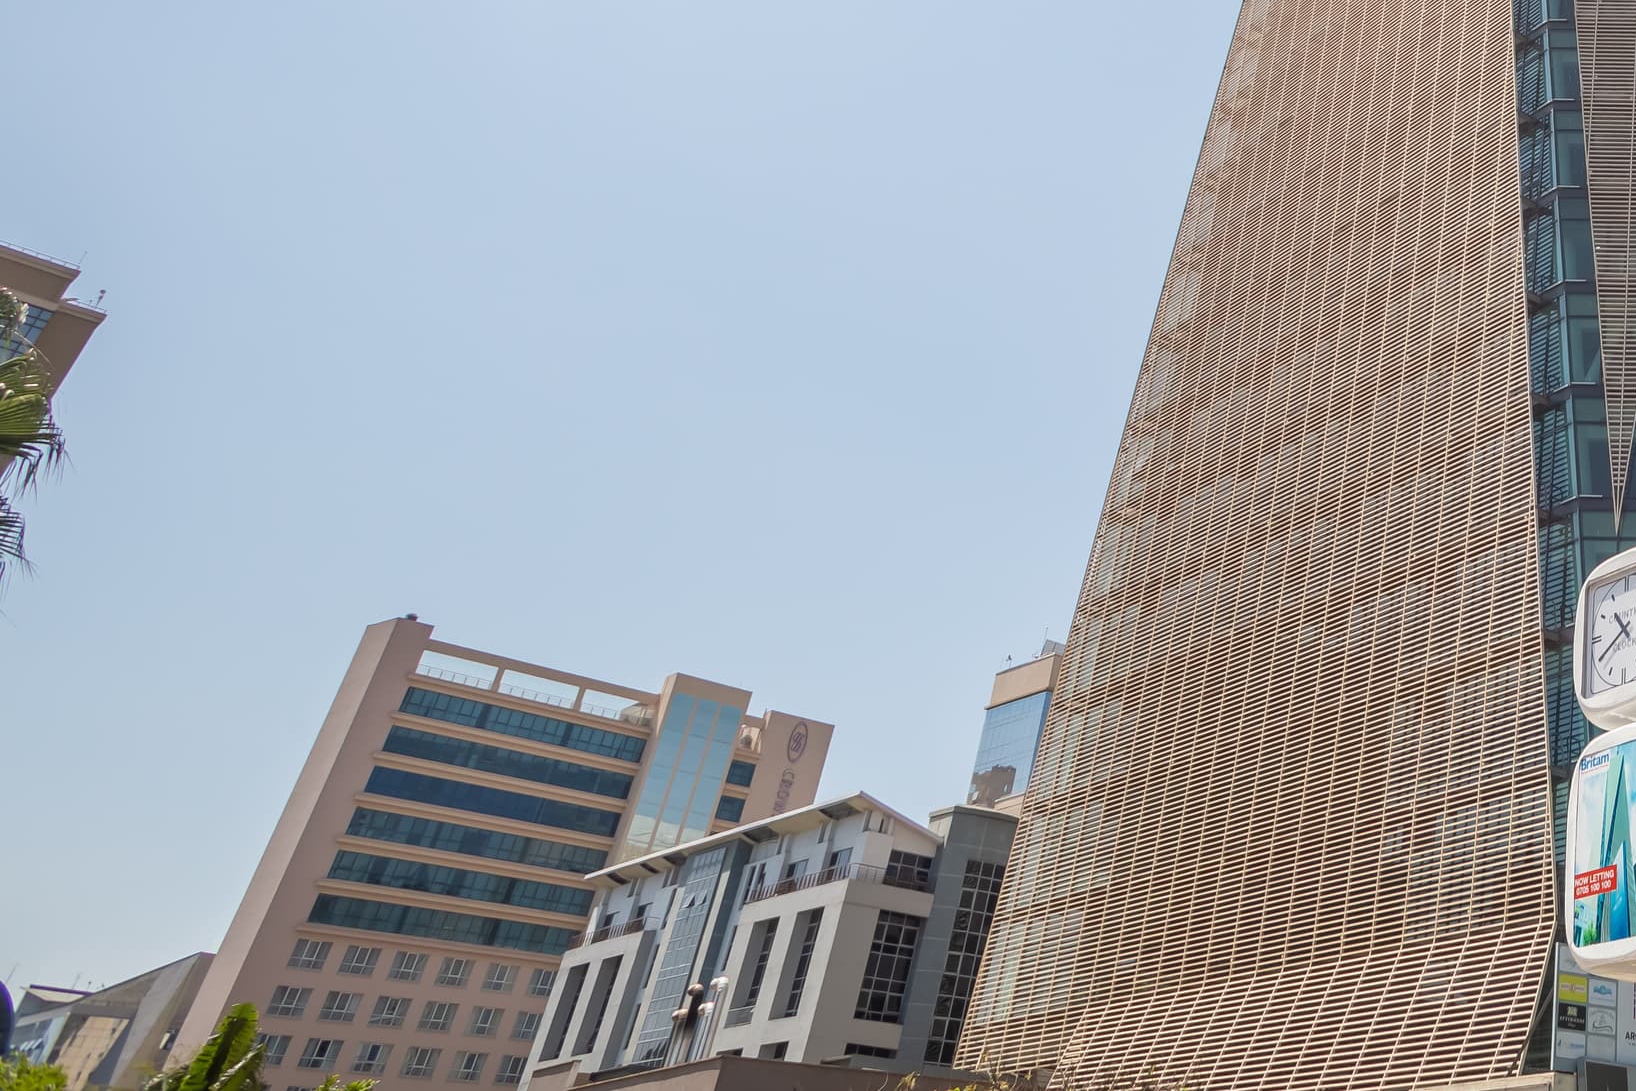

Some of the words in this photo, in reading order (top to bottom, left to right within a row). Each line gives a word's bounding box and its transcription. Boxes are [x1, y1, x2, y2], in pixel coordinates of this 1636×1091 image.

[1581, 753, 1609, 770] Britam
[1575, 876, 1589, 886] NOW
[1590, 870, 1615, 883] LETTING
[1590, 882, 1601, 893] 100
[1602, 879, 1612, 889] 100
